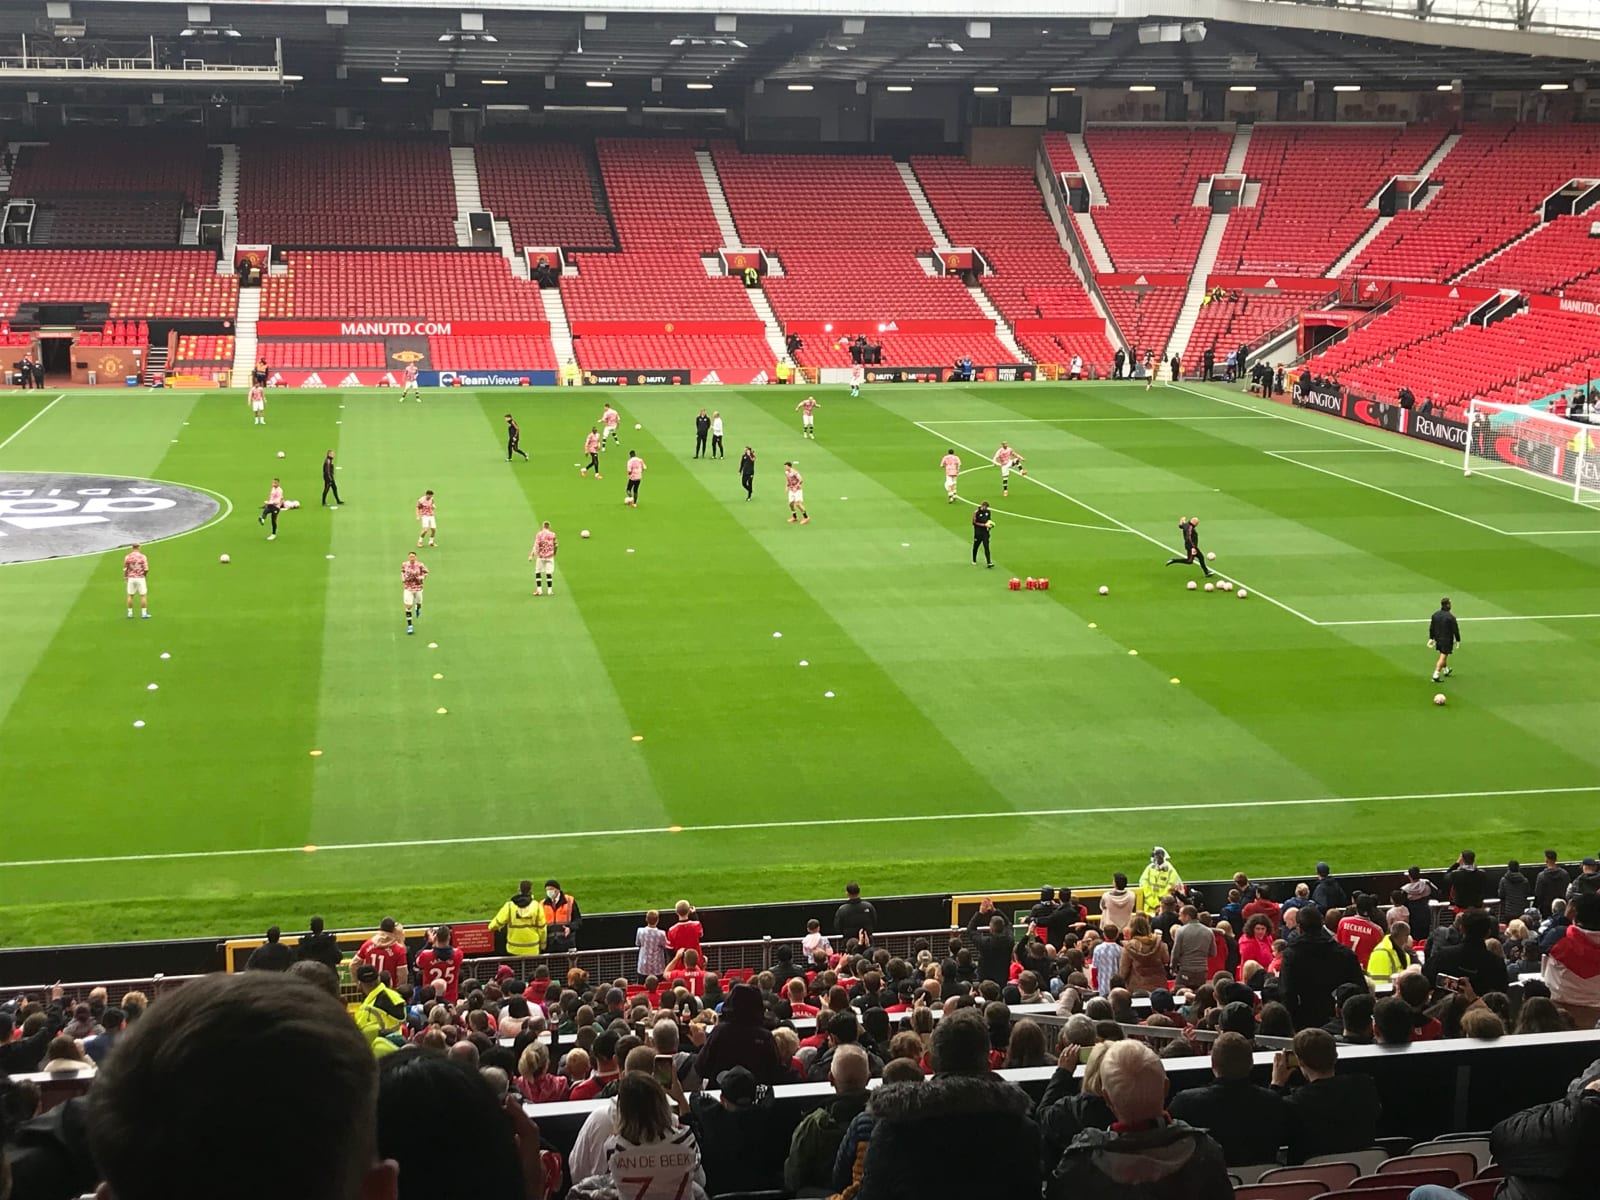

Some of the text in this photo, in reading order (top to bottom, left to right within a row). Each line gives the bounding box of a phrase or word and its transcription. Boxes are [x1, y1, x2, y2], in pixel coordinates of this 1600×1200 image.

[341, 322, 451, 336] MANUTD.COM
[459, 374, 522, 385] TeamViewe
[1415, 415, 1473, 446] REMINGTO
[1343, 922, 1372, 935] BECKHAM
[1350, 935, 1360, 952] 7
[370, 953, 385, 974] 11
[429, 966, 456, 985] 25
[614, 1152, 691, 1169] VAN DE BEEK
